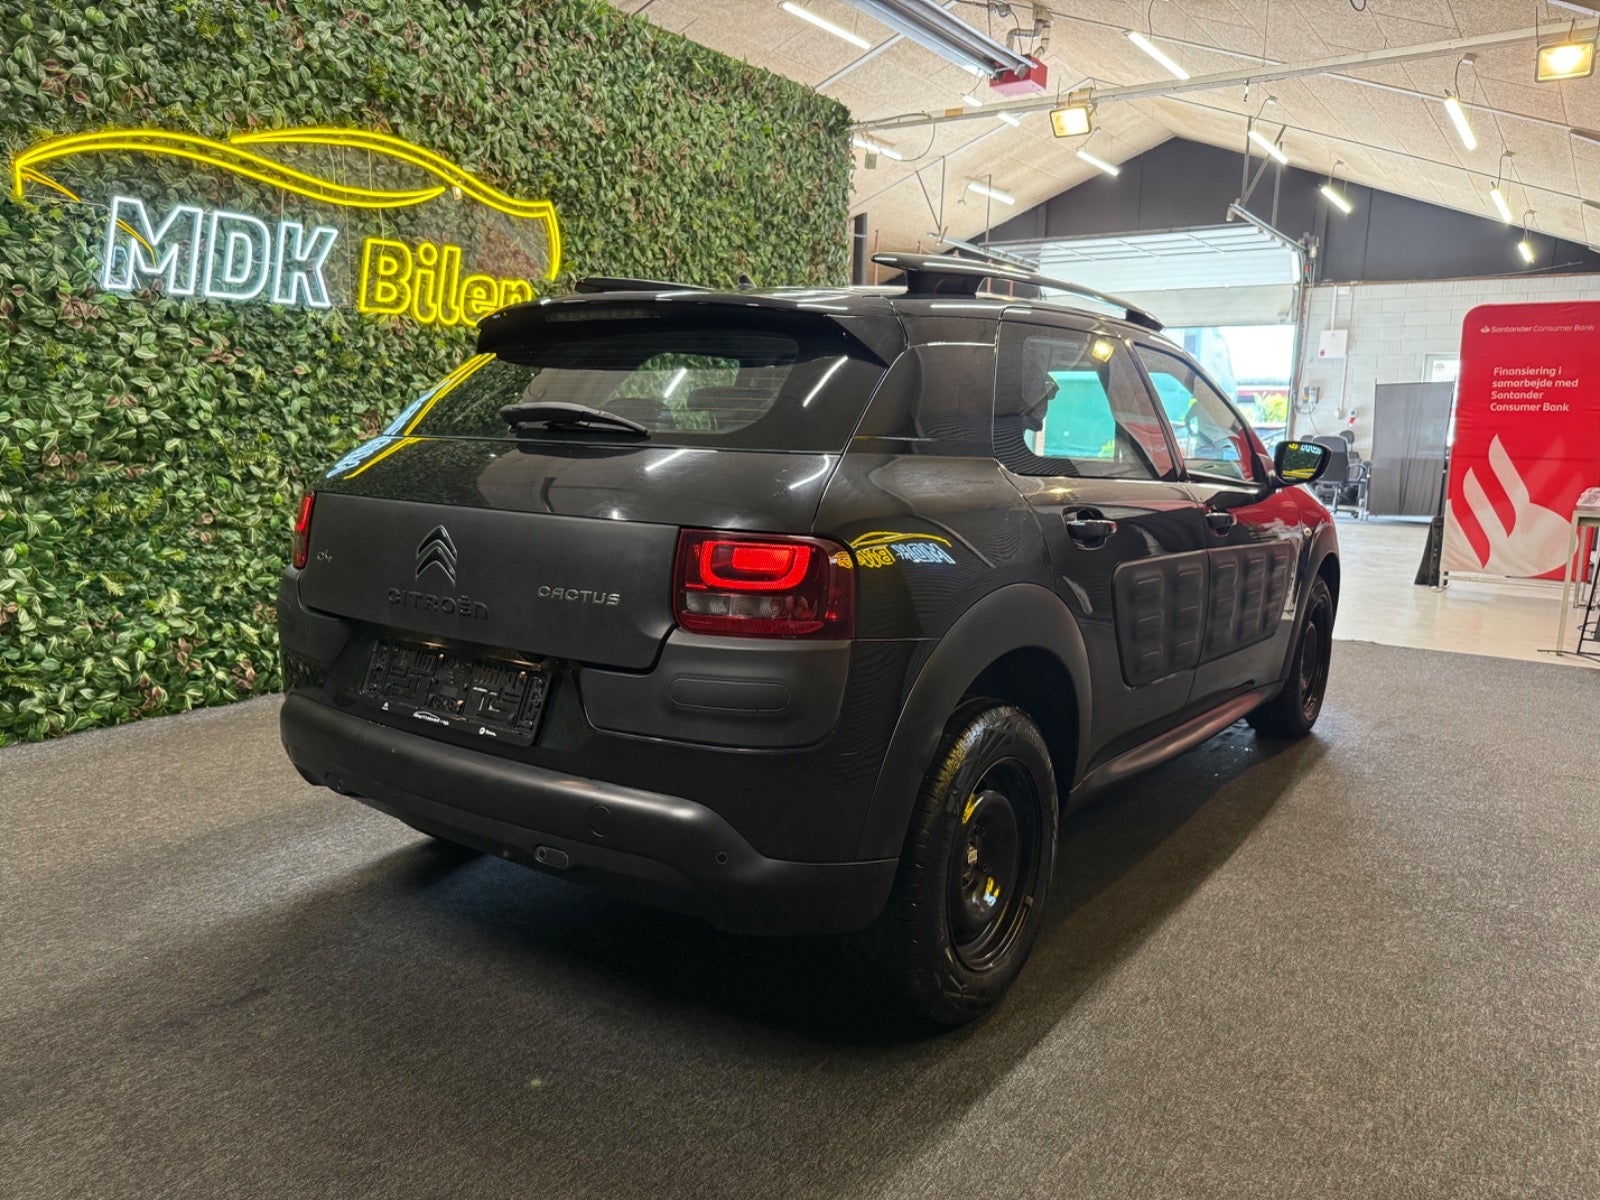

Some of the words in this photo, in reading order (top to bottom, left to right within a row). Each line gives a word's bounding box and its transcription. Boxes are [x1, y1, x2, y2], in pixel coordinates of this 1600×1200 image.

[102, 196, 338, 308] MDK
[1491, 325, 1533, 333] Santander
[1533, 324, 1573, 332] Consumer
[1574, 323, 1595, 332] Bank
[1493, 366, 1556, 377] Finansiering
[1492, 378, 1553, 389] samarbejde
[1554, 378, 1579, 388] med
[1491, 390, 1544, 400] Santander
[1490, 402, 1541, 411] Consumer
[1543, 402, 1569, 412] Bank
[537, 585, 621, 606] CACTUS
